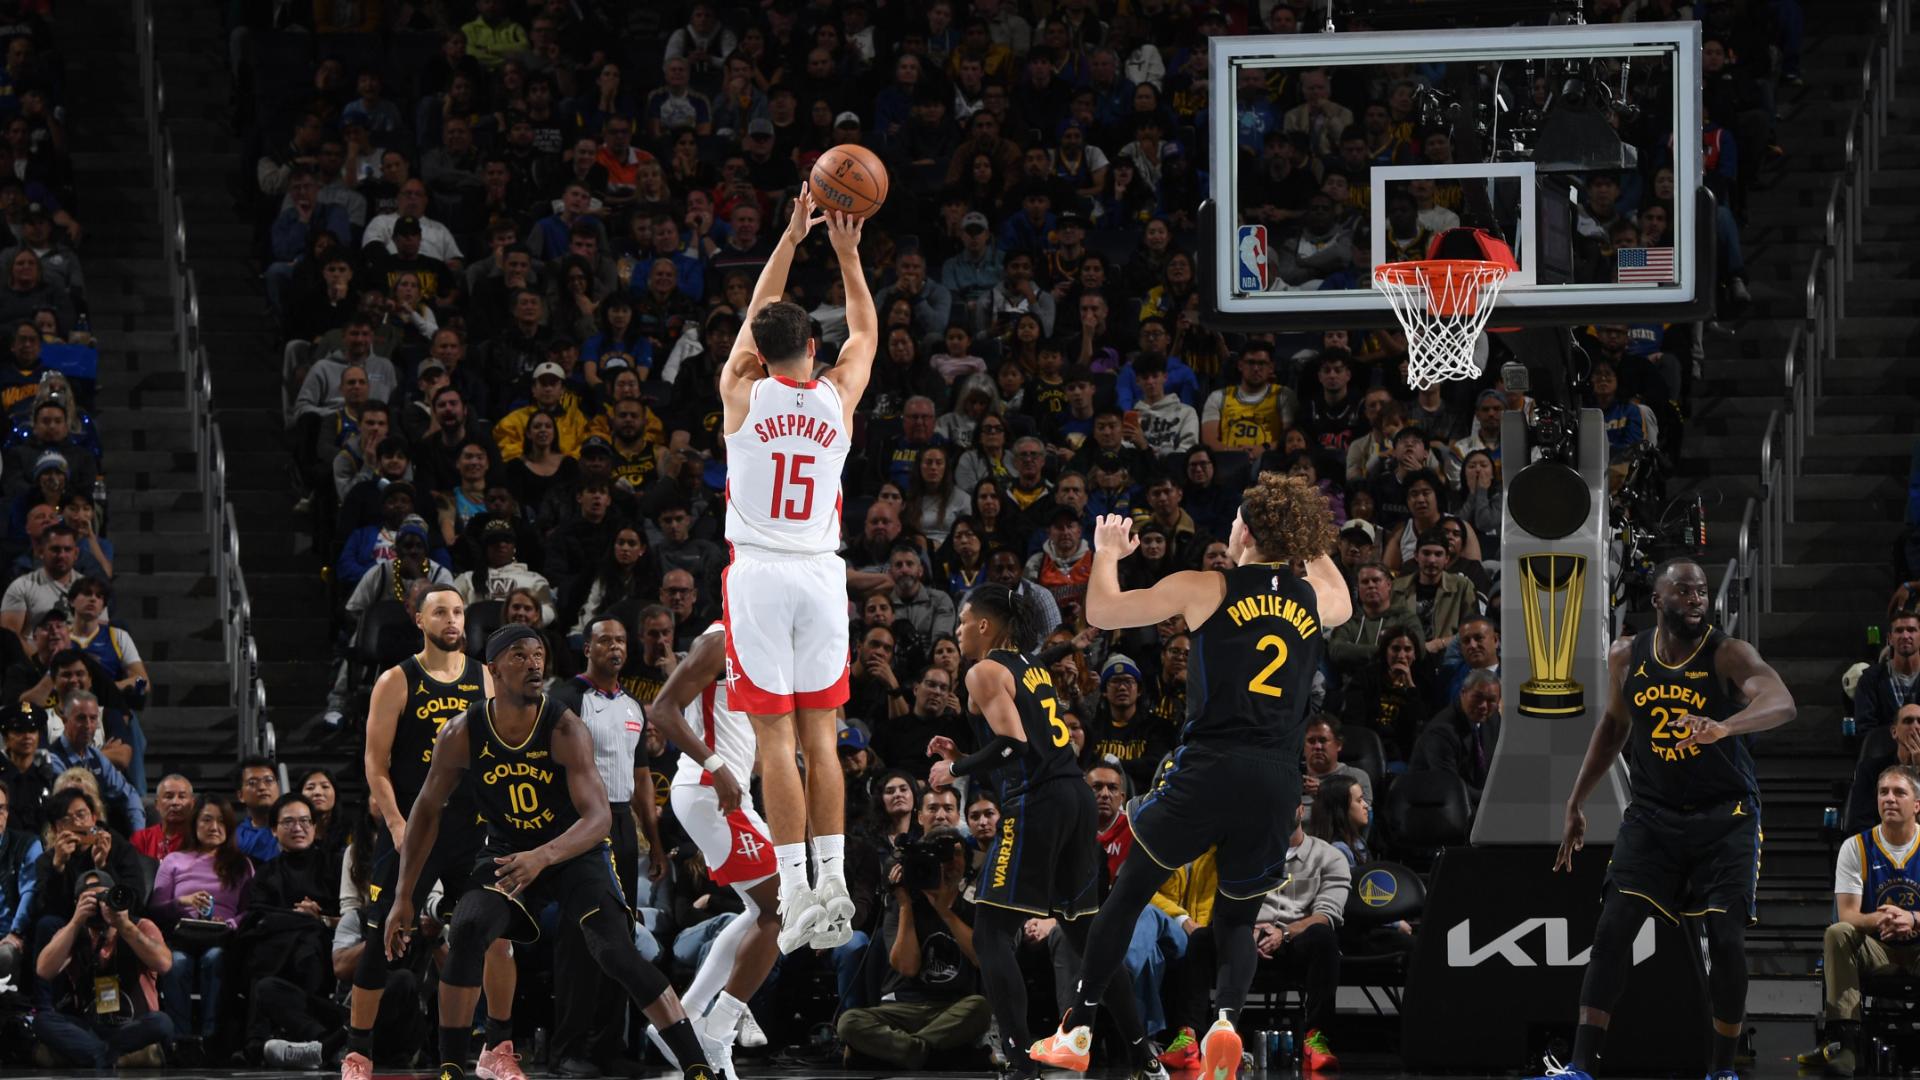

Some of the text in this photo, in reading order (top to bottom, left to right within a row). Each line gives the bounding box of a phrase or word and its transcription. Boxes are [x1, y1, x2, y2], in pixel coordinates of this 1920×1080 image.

[1242, 277, 1257, 289] NBA
[1050, 398, 1062, 412] 10
[754, 414, 837, 449] SHEPPARD
[1235, 422, 1258, 438] 30
[770, 452, 816, 521] 15
[1226, 594, 1318, 641] PODZIEMSKI
[1248, 633, 1288, 699] 2
[416, 697, 472, 721] GOLDE
[1633, 684, 1707, 710] GOLDEN
[1040, 697, 1072, 749] 3
[1650, 705, 1693, 739] 23
[1651, 741, 1702, 763] STATE
[483, 763, 554, 786] GOLDEN
[508, 782, 540, 816] 10
[504, 808, 556, 831] STATE
[992, 817, 1016, 887] WARRIORS
[1898, 891, 1916, 907] 23
